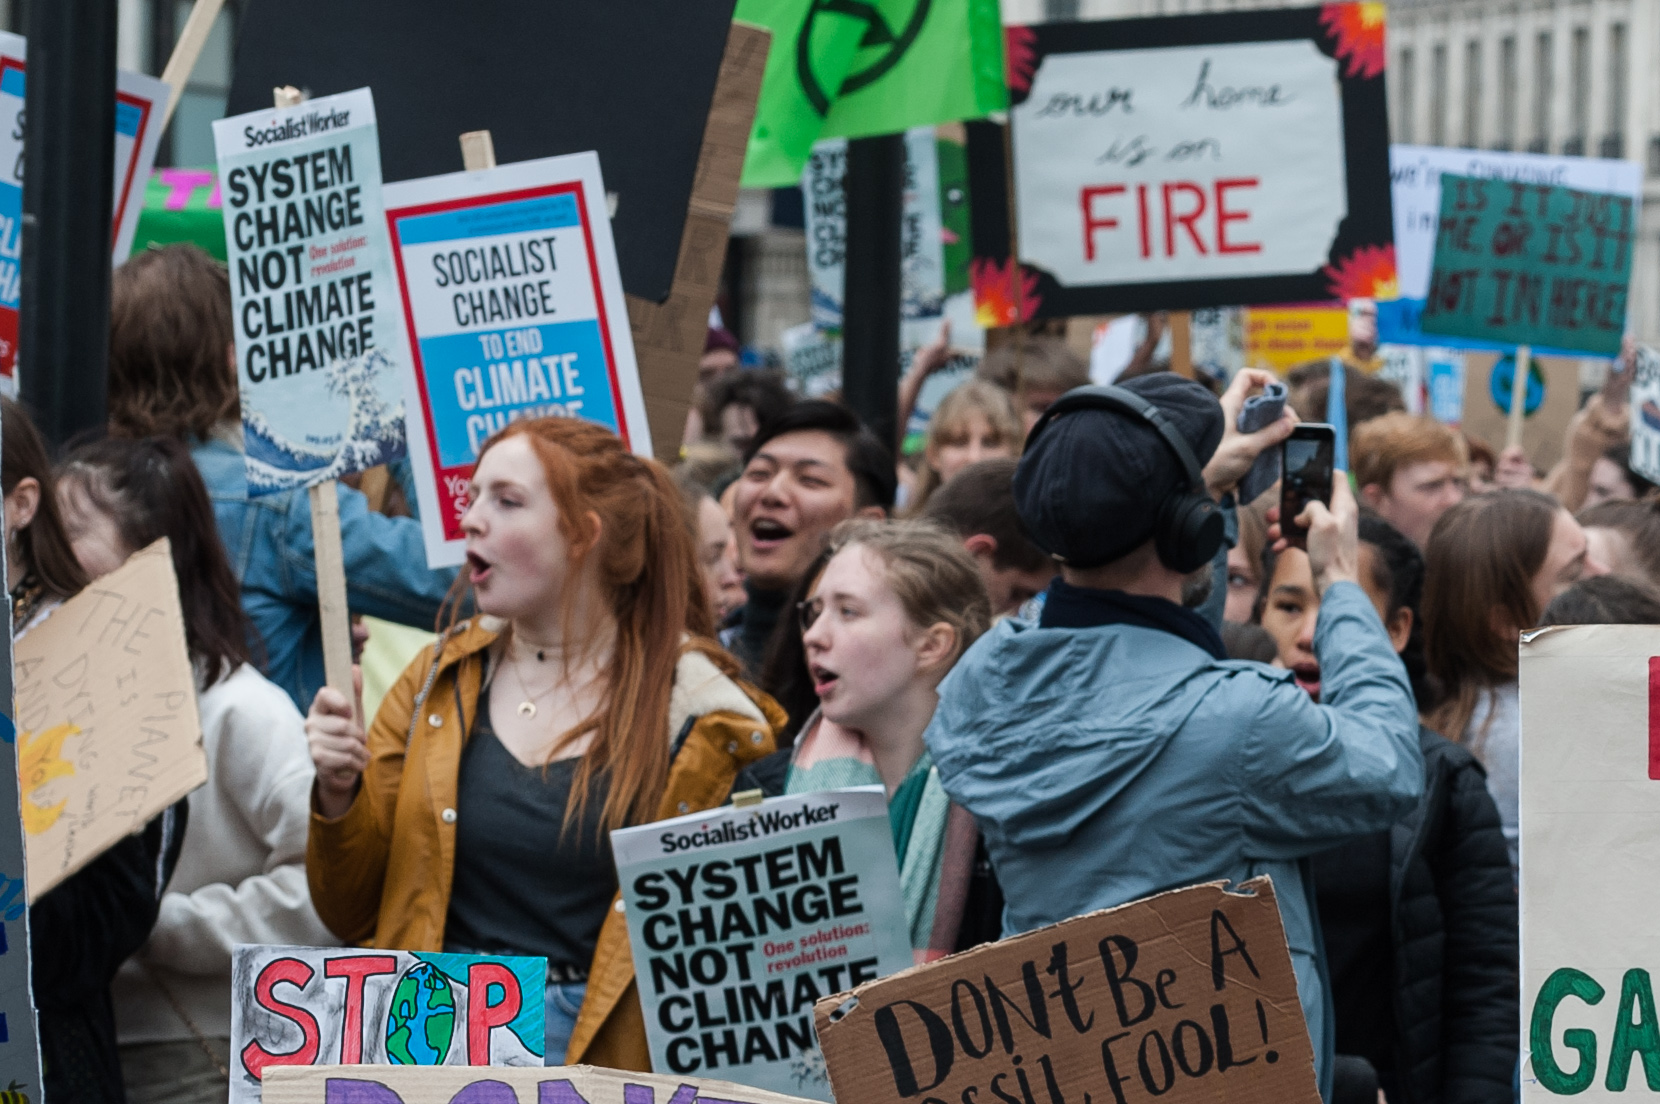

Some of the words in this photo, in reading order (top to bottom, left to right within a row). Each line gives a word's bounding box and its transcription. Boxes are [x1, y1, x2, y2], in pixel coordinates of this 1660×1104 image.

[228, 144, 353, 208] SYSTEM
[234, 186, 364, 251] CHANGE
[1079, 176, 1262, 262] FIRE
[238, 245, 304, 297] NOT
[432, 237, 557, 288] SOCIALIST
[243, 271, 375, 339] CLIMATE
[453, 280, 556, 327] CHANGE
[247, 315, 375, 383] CHANGE
[478, 333, 502, 361] TO
[503, 327, 544, 358] END
[453, 352, 585, 411] CLIMATE
[78, 588, 165, 655] THE
[633, 836, 845, 911] SYSTEM
[642, 875, 864, 952] CHANGE
[649, 942, 755, 996] NOT
[763, 940, 795, 957] One
[800, 922, 870, 948] solution:
[767, 944, 848, 975] revolution
[1210, 908, 1260, 990] A
[665, 1016, 818, 1075] CHAN
